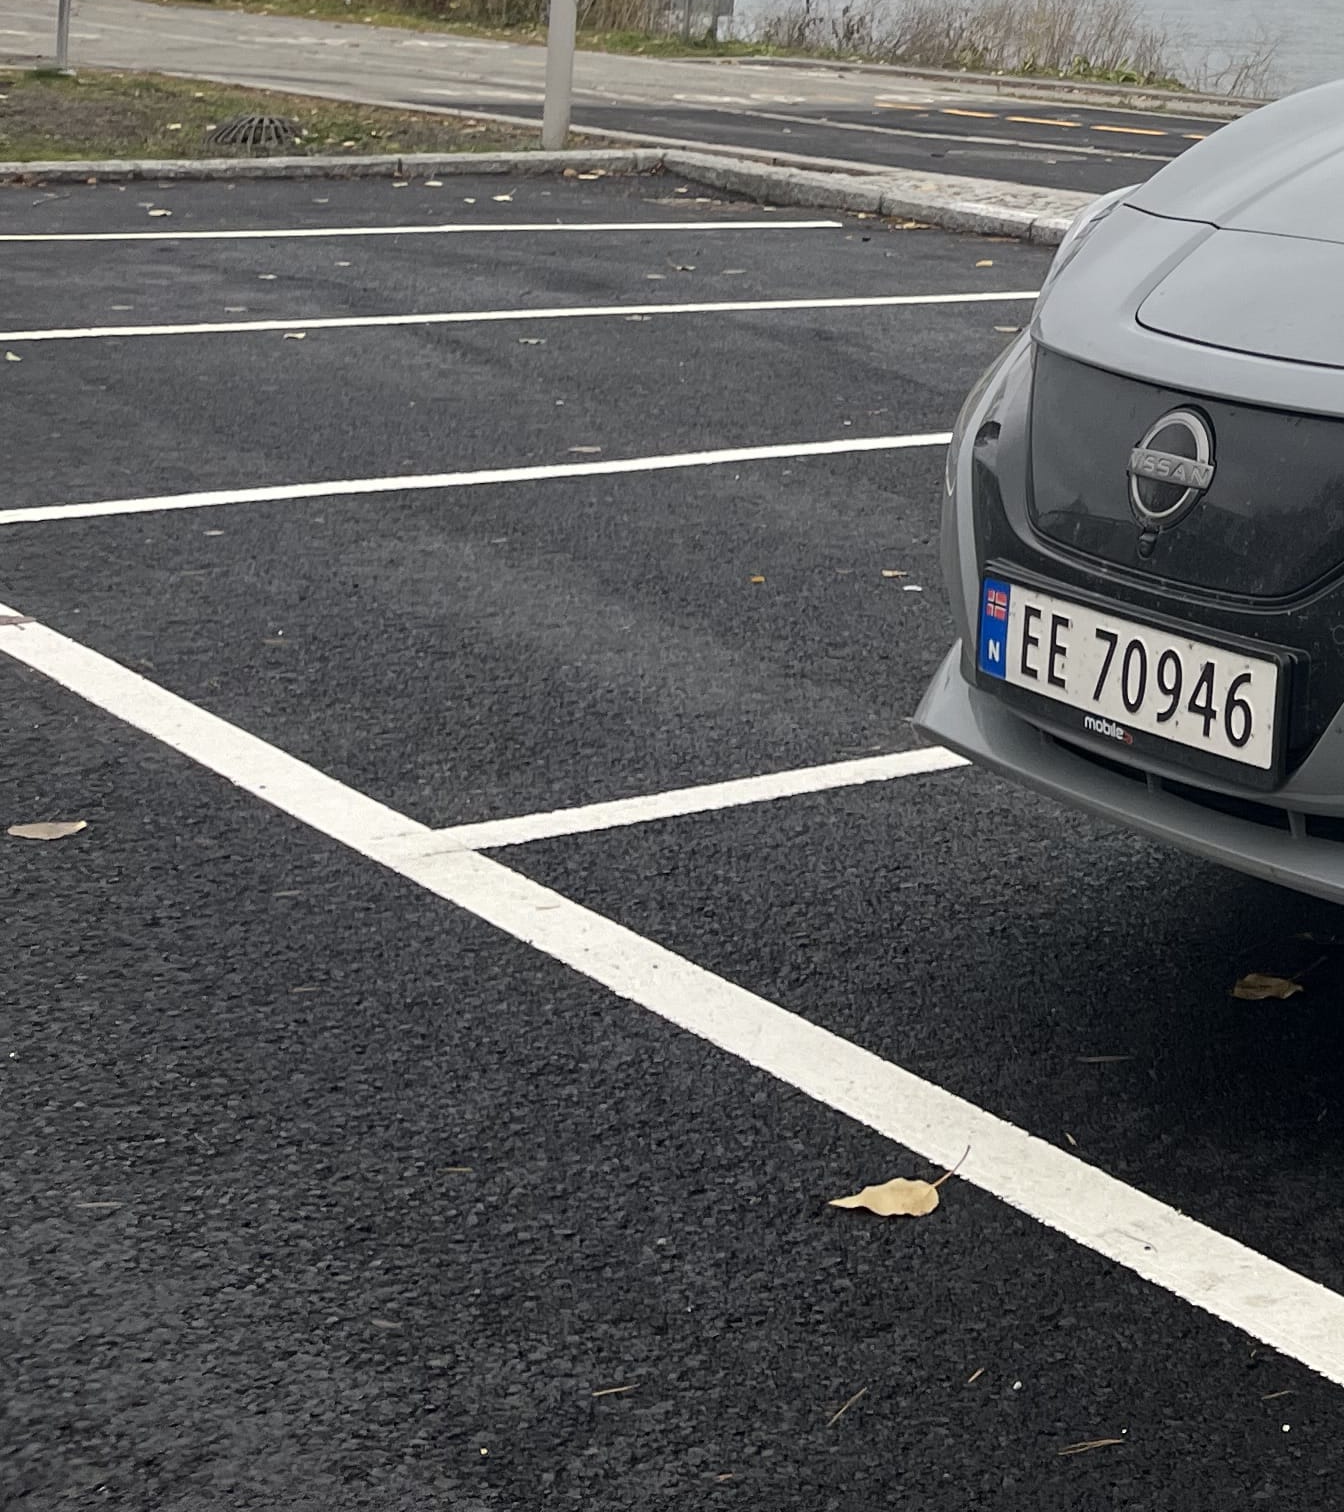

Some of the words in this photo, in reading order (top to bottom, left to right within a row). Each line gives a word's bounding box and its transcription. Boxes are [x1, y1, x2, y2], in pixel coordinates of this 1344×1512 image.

[1129, 450, 1210, 486] NISSAN
[988, 638, 1000, 663] N
[1020, 604, 1070, 689] EE
[1092, 627, 1253, 748] 70946
